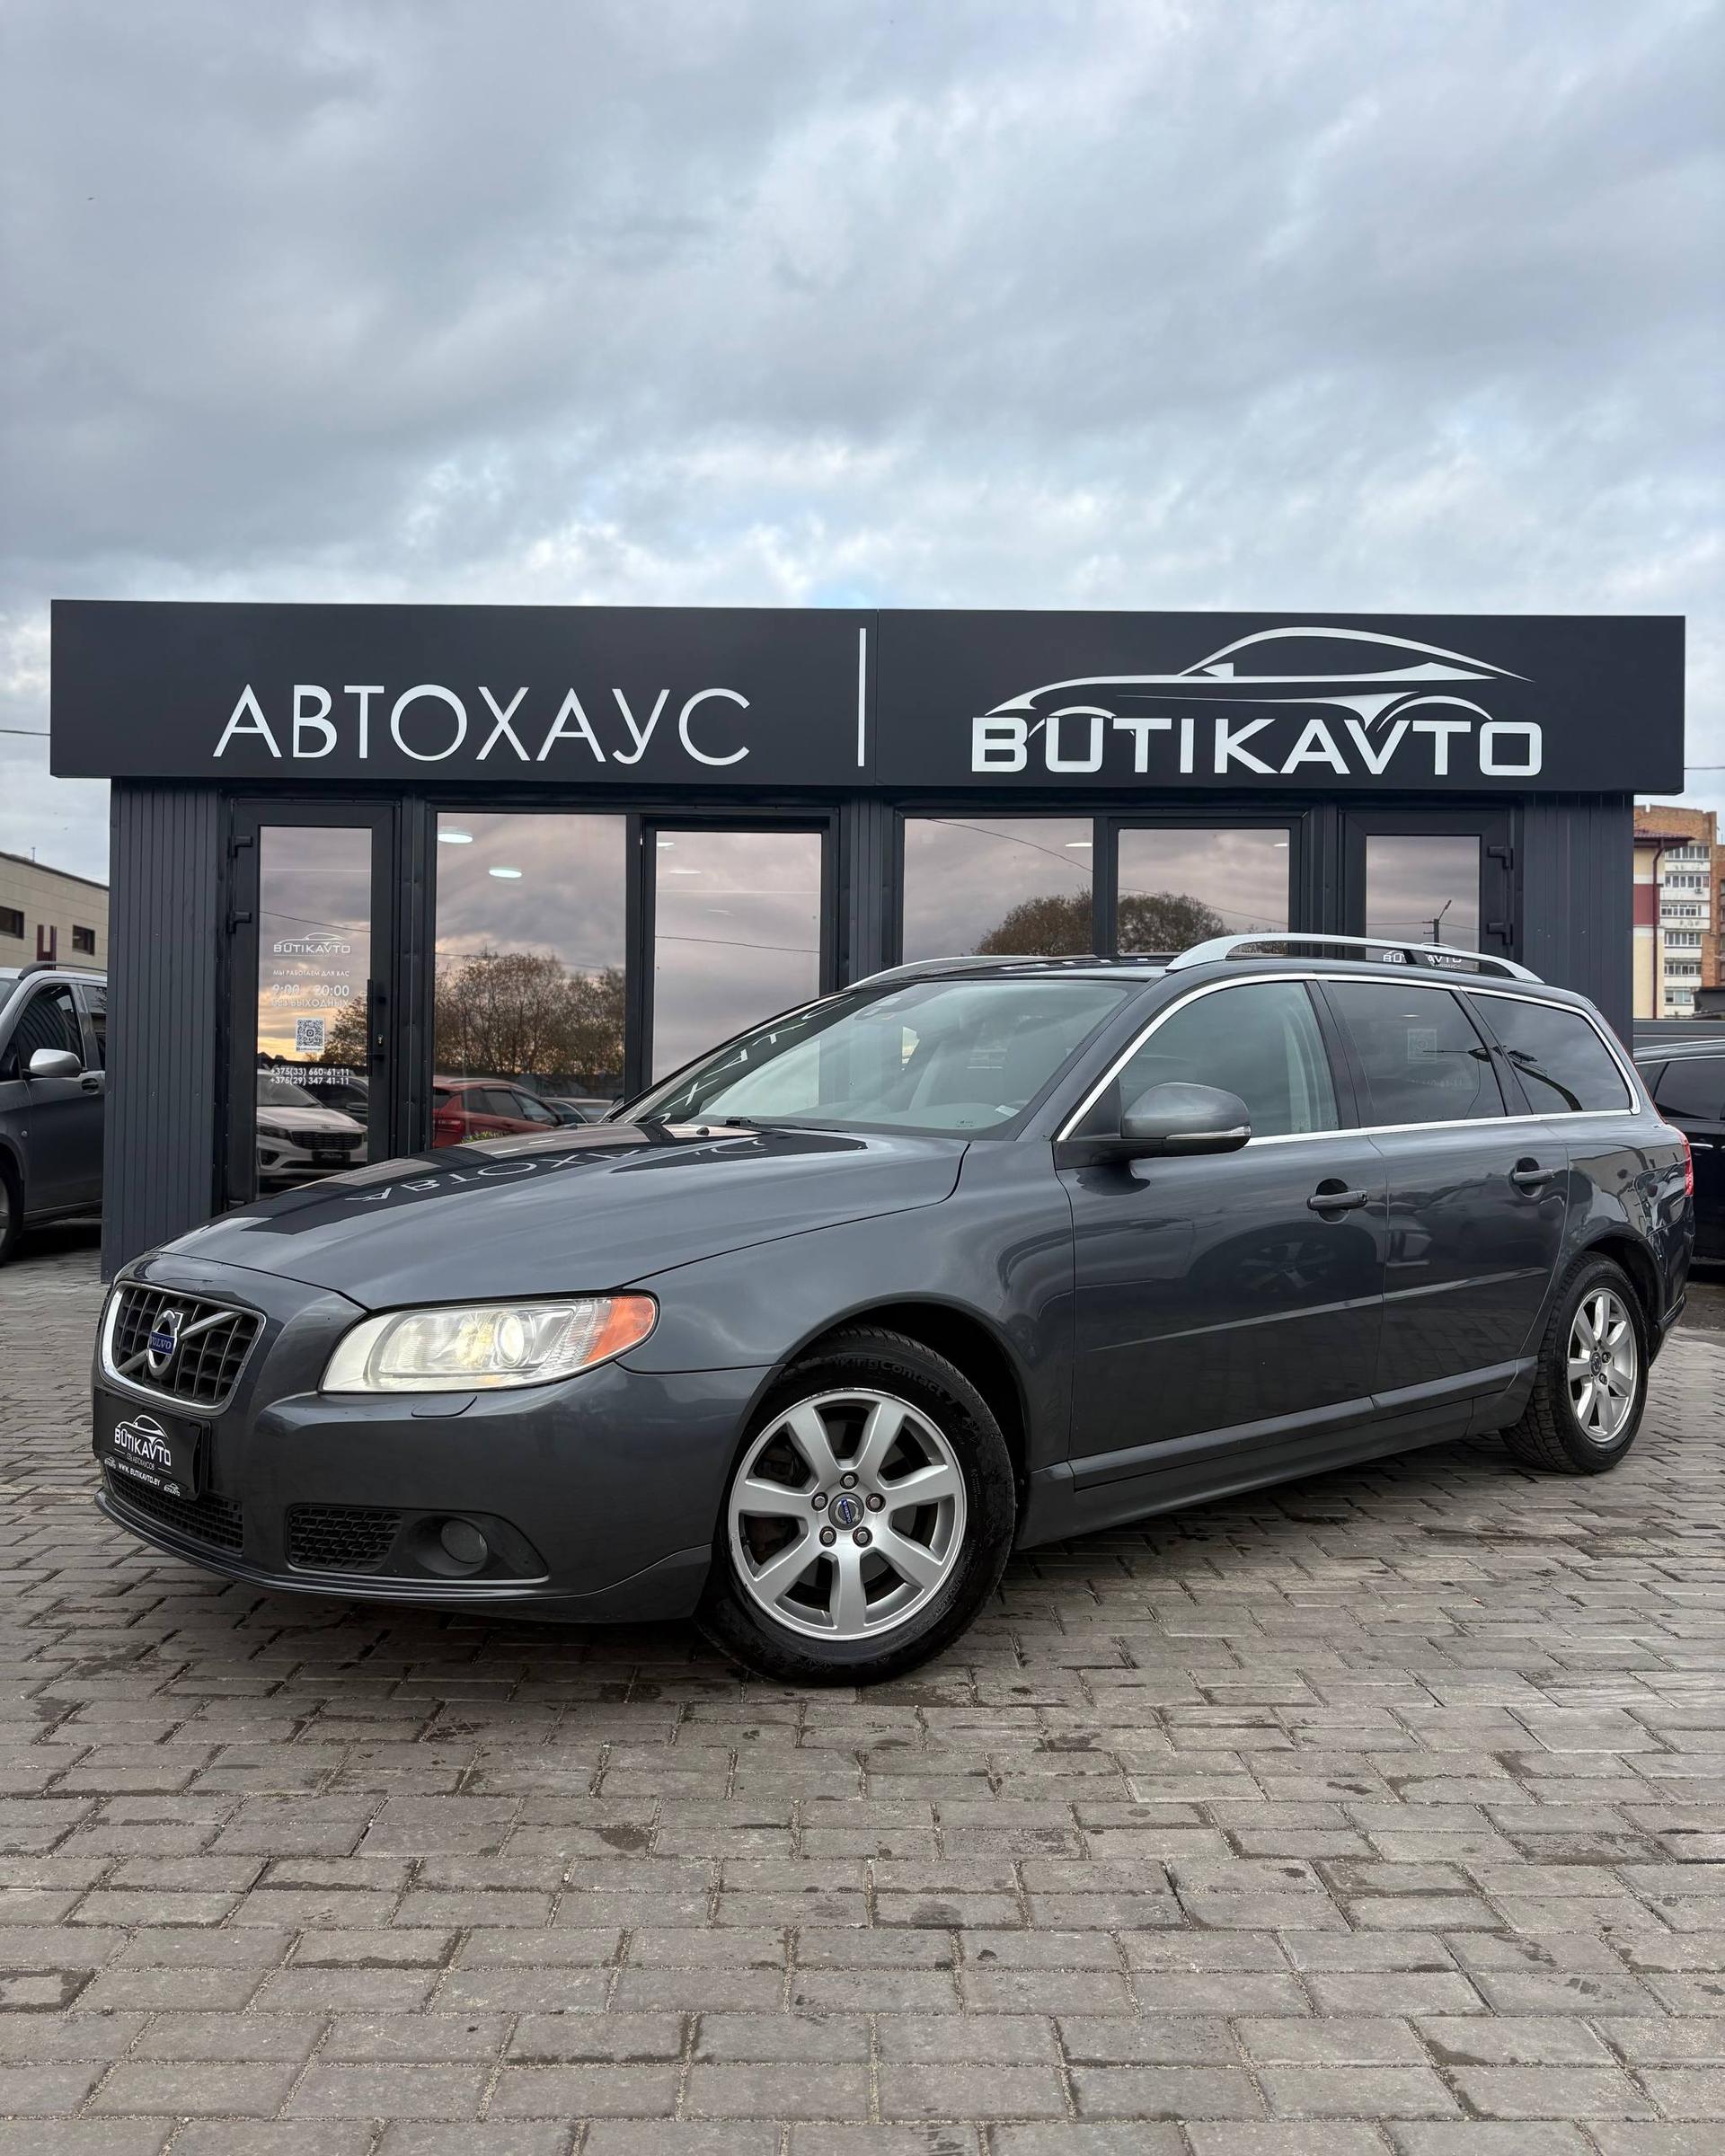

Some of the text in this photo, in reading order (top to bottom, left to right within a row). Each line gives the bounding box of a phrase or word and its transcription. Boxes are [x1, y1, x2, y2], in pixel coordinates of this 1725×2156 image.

[213, 683, 751, 767] АВТОХАУС
[971, 715, 1544, 778] BUTIKAVTO
[272, 943, 351, 954] BUTIKAVTO
[314, 985, 349, 996] 20:00
[270, 1067, 349, 1077] +375(33) 660-61-11
[270, 1076, 306, 1086] +375(29)
[149, 1336, 172, 1350] VOLVO
[114, 1427, 172, 1467] BUTIKAVTO
